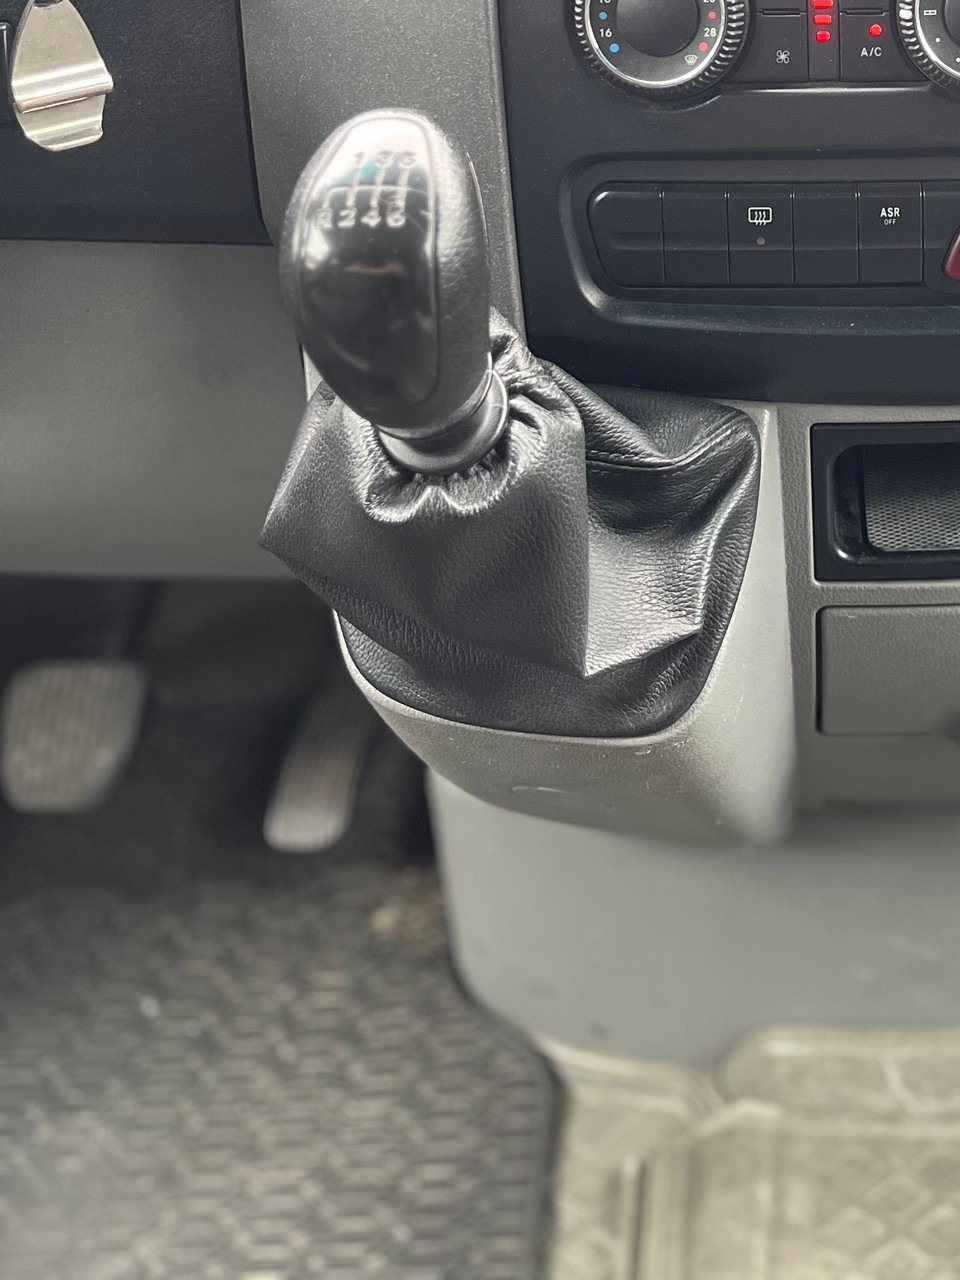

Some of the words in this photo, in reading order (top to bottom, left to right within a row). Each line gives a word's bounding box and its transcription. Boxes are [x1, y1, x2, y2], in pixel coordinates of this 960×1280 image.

[599, 28, 613, 38] 16
[703, 27, 717, 38] 28
[860, 46, 882, 57] A/C
[338, 209, 356, 227] 2
[361, 208, 381, 228] 4
[880, 207, 900, 218] ASR
